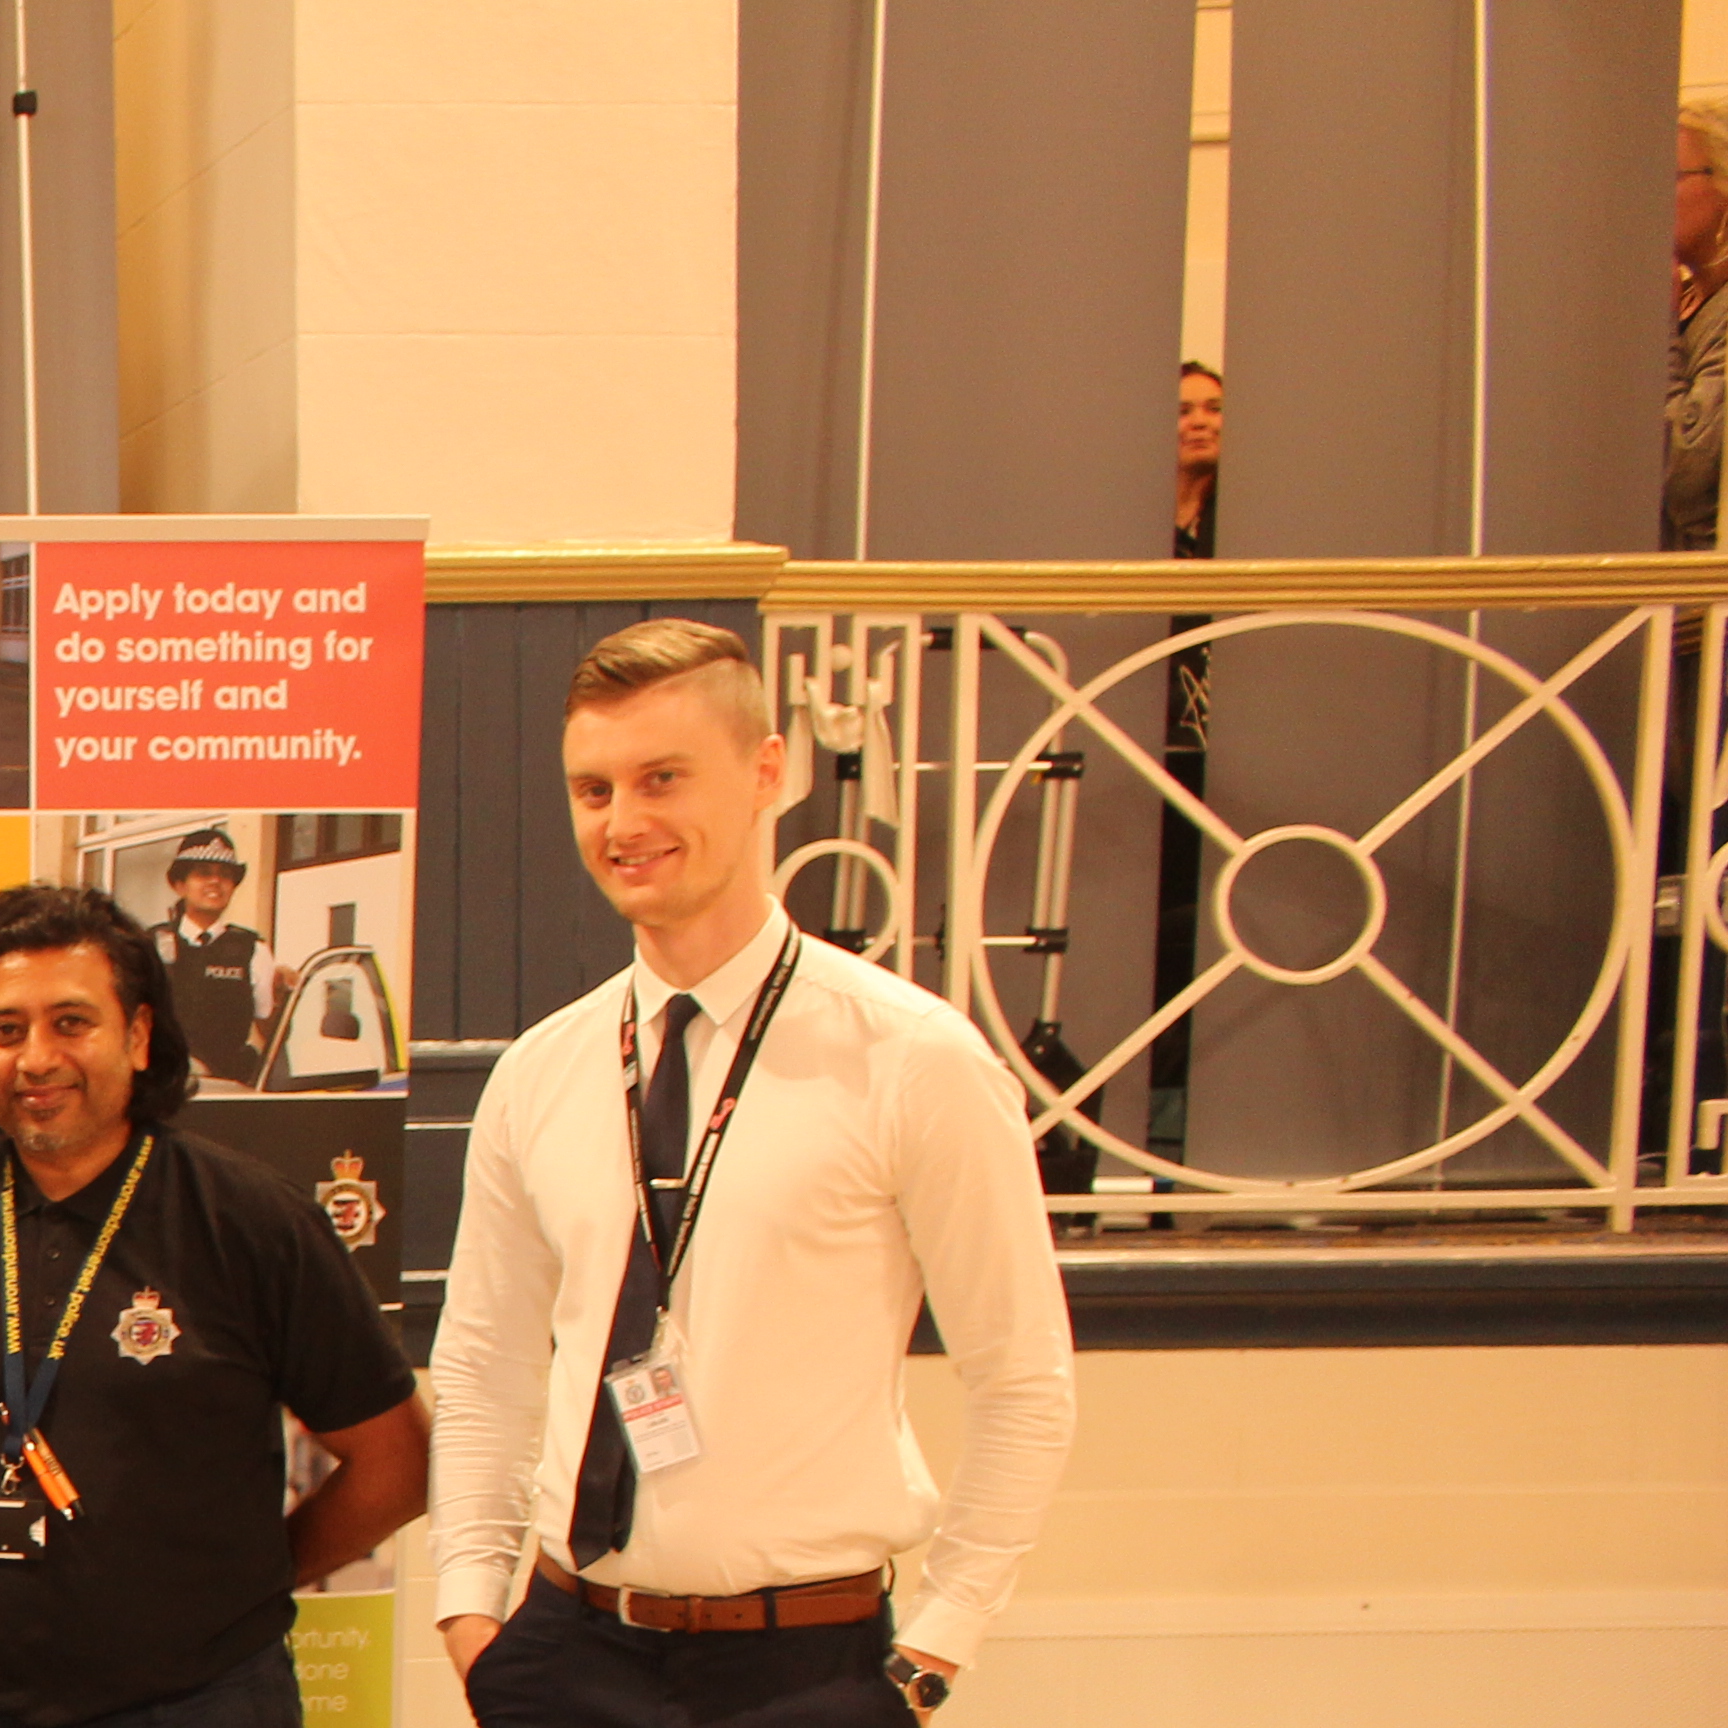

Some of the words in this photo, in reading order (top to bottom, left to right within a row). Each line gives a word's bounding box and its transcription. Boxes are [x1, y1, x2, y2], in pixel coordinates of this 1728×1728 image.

[52, 581, 163, 621] Apply
[173, 581, 283, 621] today
[292, 581, 367, 614] and
[54, 631, 106, 662] do
[116, 630, 313, 671] something
[324, 629, 374, 662] for
[54, 678, 204, 719] yourself
[213, 678, 288, 711] and
[54, 735, 138, 769] your
[147, 728, 362, 768] community.
